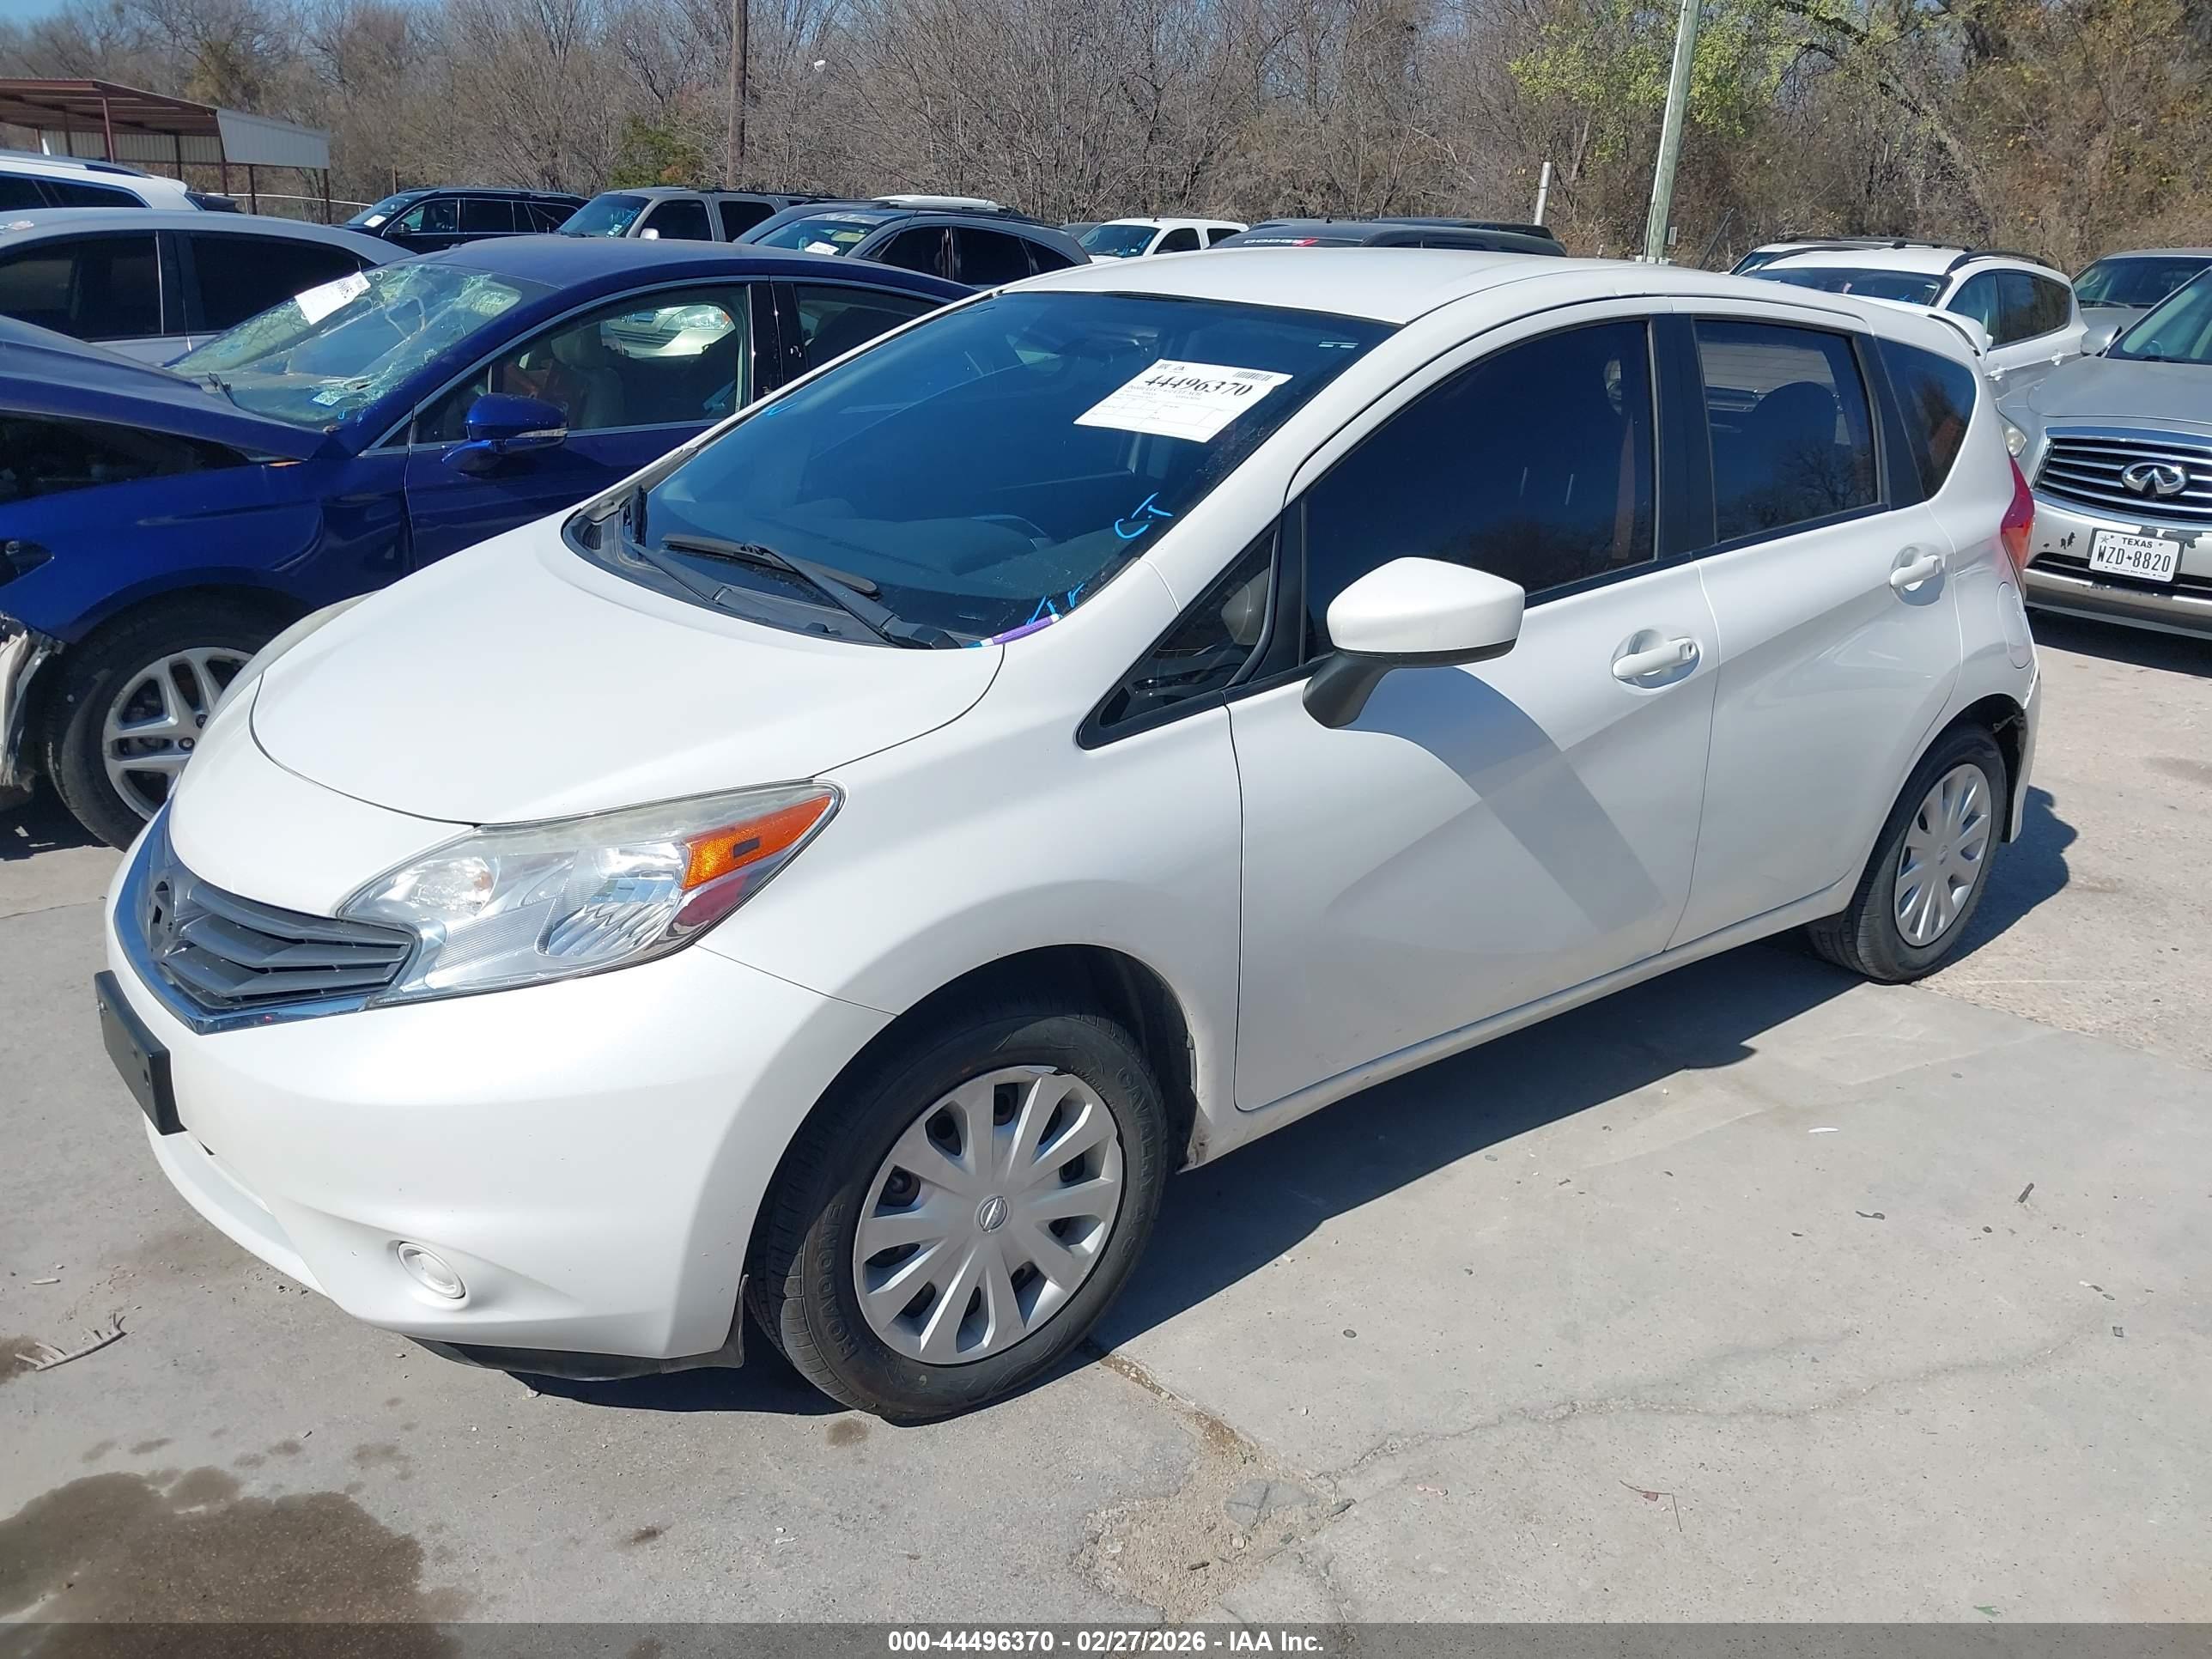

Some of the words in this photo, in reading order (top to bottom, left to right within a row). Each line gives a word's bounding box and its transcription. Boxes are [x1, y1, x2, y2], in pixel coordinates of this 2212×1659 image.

[1144, 374, 1254, 398] 44496370
[2122, 537, 2154, 549] TEXAS
[816, 1202, 859, 1362] ROADONE
